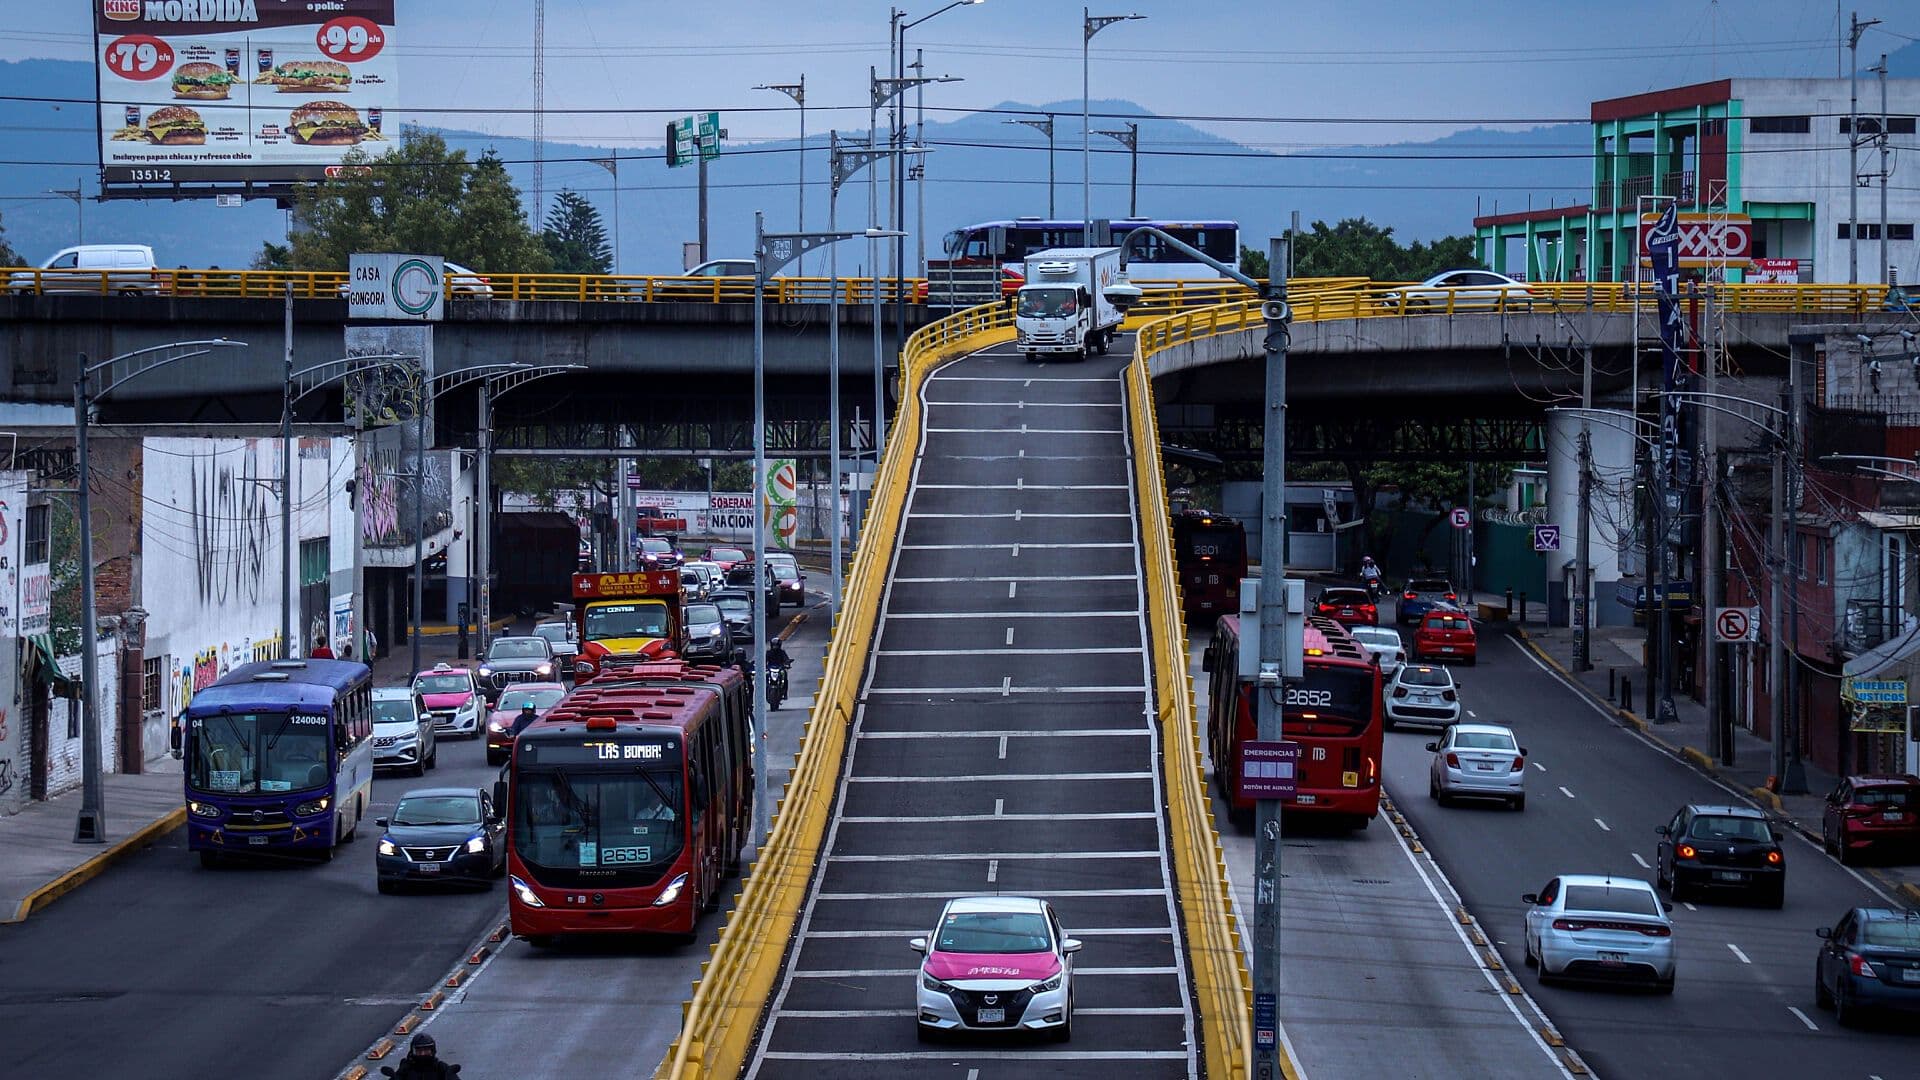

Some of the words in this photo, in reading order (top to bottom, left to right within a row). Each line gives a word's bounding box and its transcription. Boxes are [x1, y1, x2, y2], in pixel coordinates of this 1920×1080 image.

[106, 2, 138, 12] KING
[144, 0, 259, 22] MORDIDA
[315, 1, 344, 12] pollo:
[200, 152, 231, 160] refresco
[232, 152, 252, 160] chico
[130, 169, 171, 181] 1351-2
[356, 267, 380, 281] CASA
[350, 291, 386, 305] GONGORA
[600, 573, 648, 596] GAS
[1853, 681, 1905, 690] MUEBLES
[1286, 689, 1332, 707] 2652
[192, 719, 203, 728] 04
[290, 716, 327, 725] 1240049
[598, 744, 619, 759] LAS
[1243, 748, 1295, 757] EMERGENCIAS
[1243, 783, 1262, 791] BOTÓN
[603, 848, 649, 863] 2635
